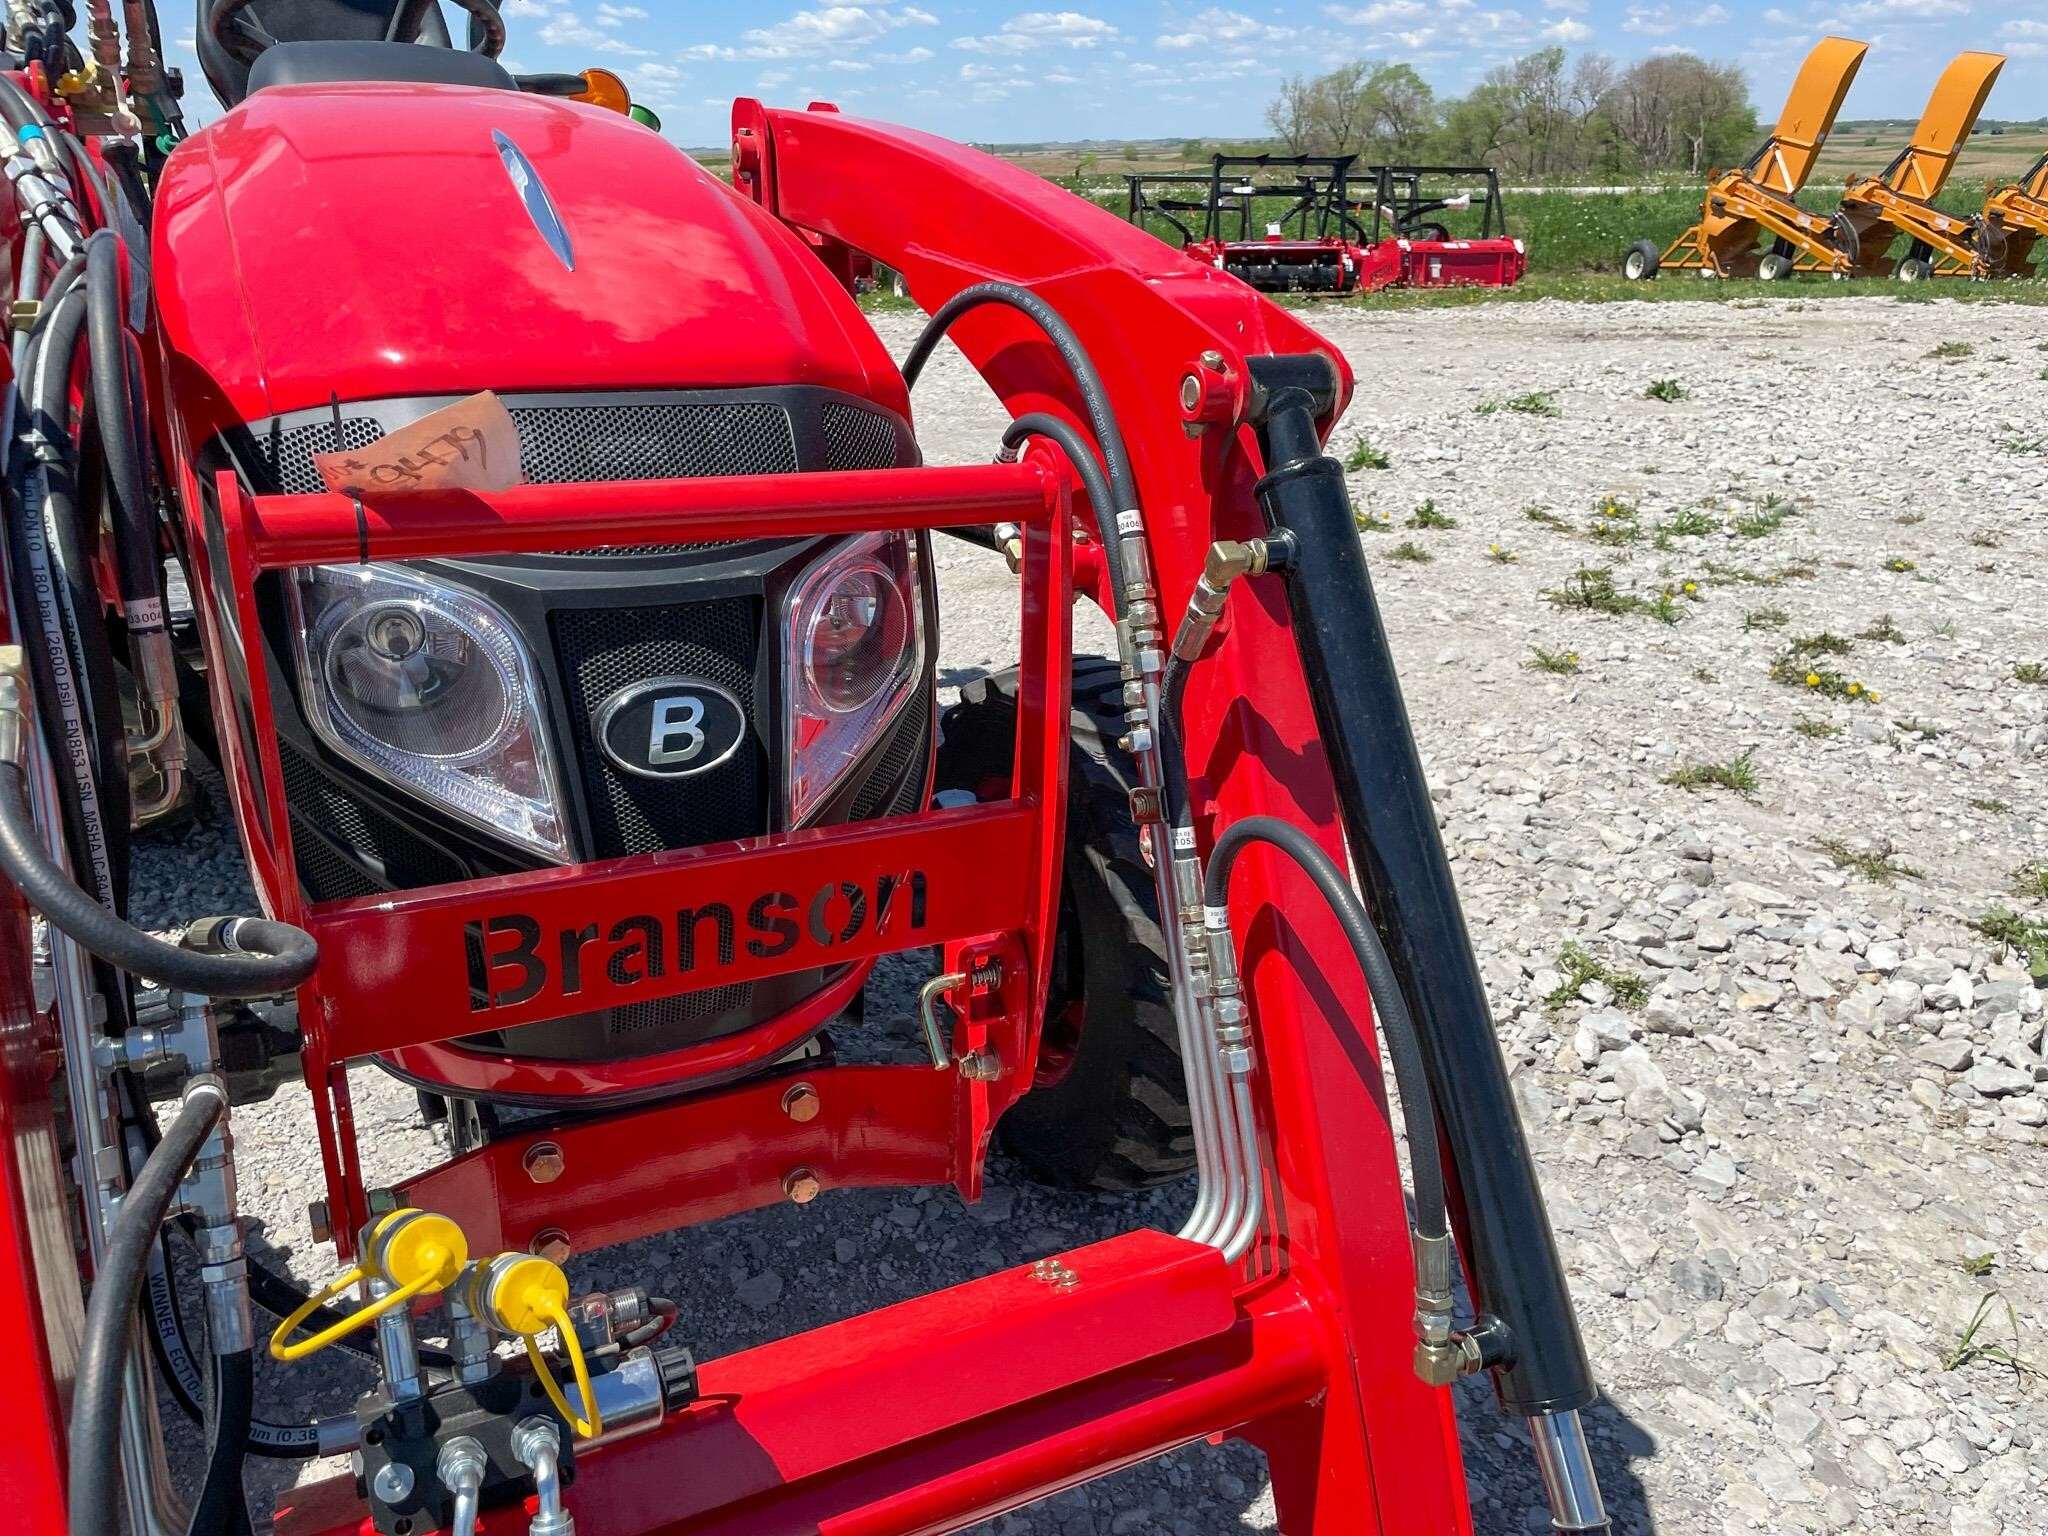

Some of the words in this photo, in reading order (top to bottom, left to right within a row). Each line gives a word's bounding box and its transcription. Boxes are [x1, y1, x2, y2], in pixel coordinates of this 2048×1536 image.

[25, 508, 42, 552] DN10
[32, 564, 50, 594] 180
[40, 599, 53, 623] bar
[46, 630, 67, 677] (2600
[56, 681, 75, 708] psi)
[65, 718, 86, 768] EN853
[647, 696, 705, 765] B
[76, 773, 93, 802] 1SN
[82, 809, 102, 852] MSHA
[463, 868, 928, 1014] Branson
[150, 1272, 176, 1339] WINNER
